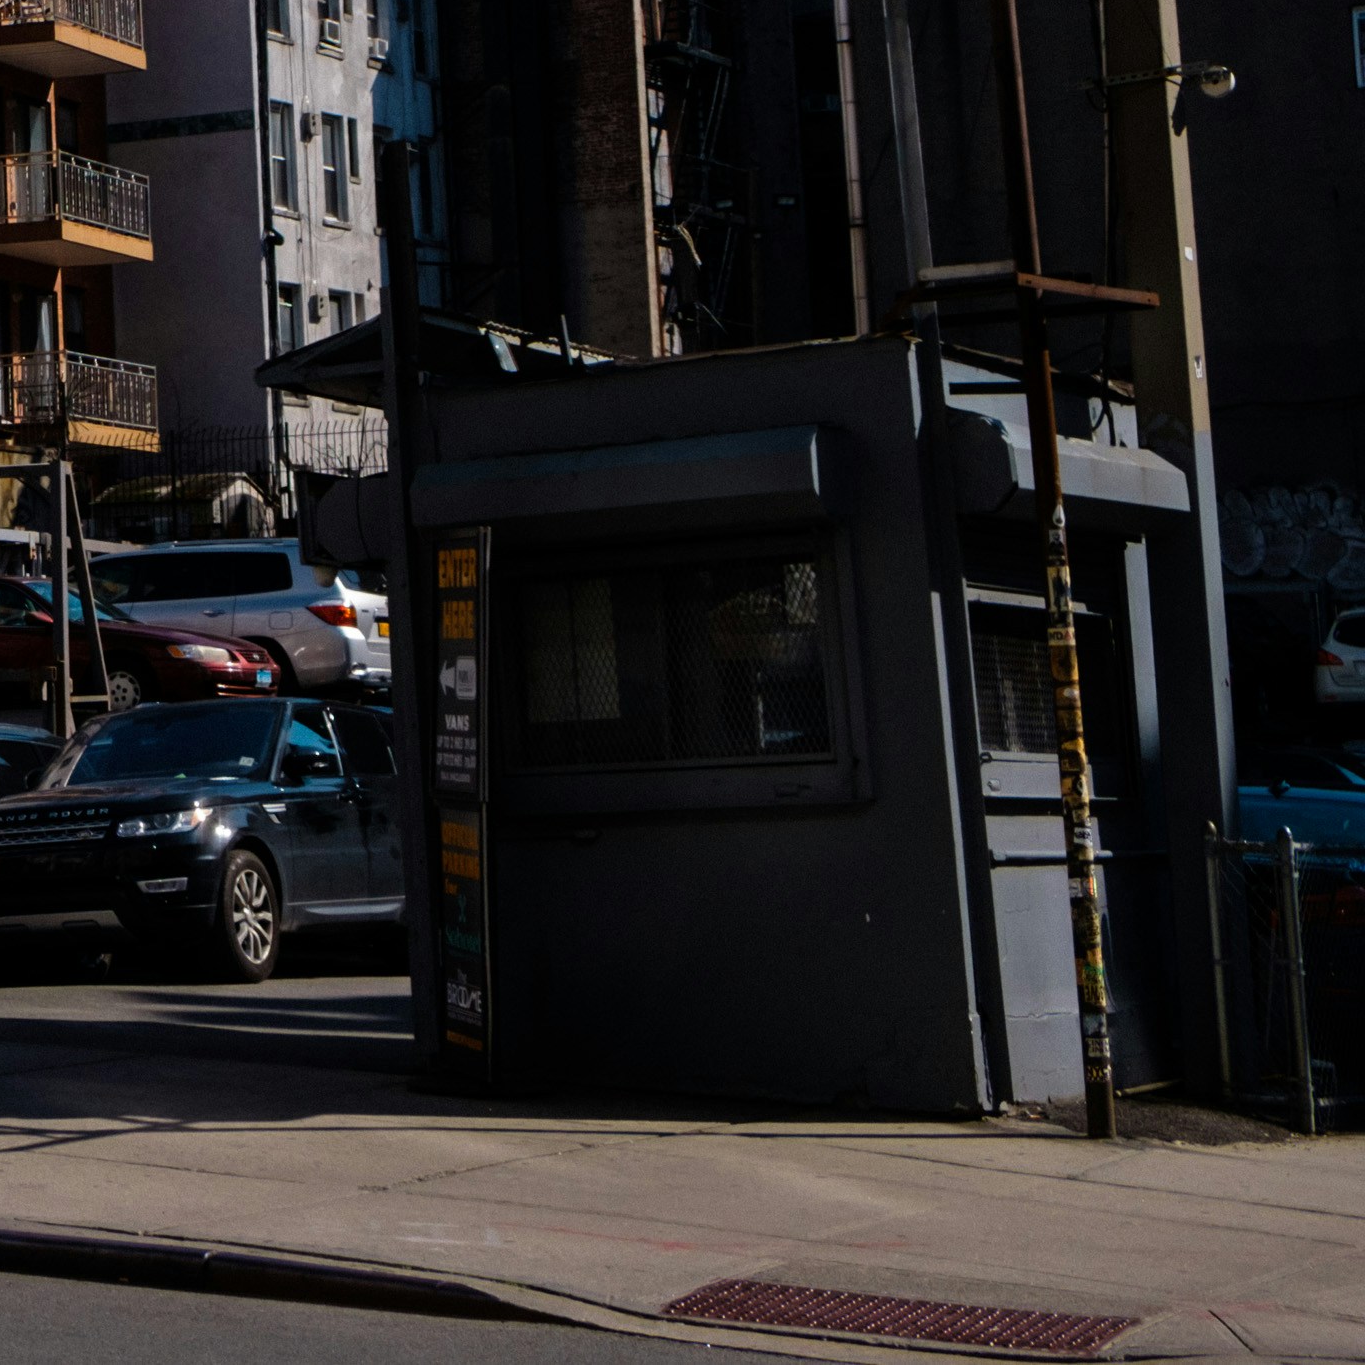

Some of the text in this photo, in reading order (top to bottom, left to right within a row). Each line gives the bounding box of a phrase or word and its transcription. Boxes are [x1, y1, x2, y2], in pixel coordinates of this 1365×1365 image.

[437, 547, 478, 589] ENTER
[441, 599, 476, 641] HERE
[445, 714, 470, 732] VANS
[49, 807, 109, 819] ROVER
